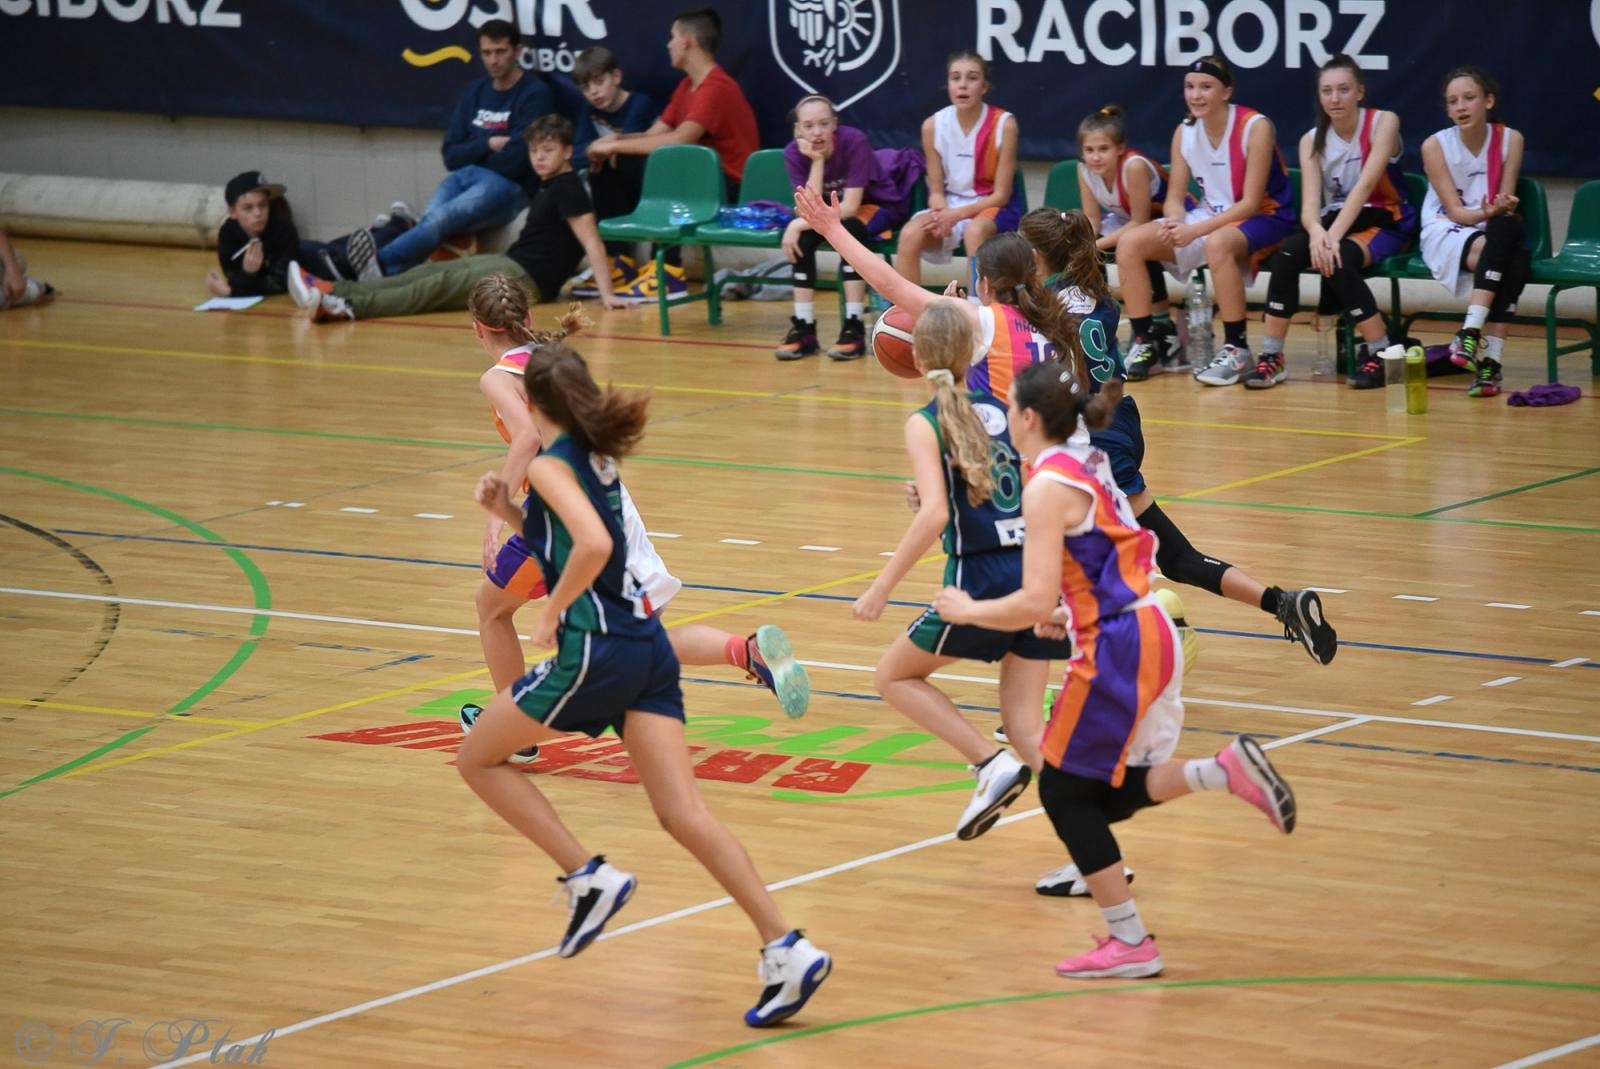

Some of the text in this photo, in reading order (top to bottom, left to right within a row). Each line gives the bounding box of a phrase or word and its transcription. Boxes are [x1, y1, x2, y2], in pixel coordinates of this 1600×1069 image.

[976, 0, 1390, 70] RACIBORZ
[1078, 317, 1116, 384] 9
[988, 439, 1020, 513] 6
